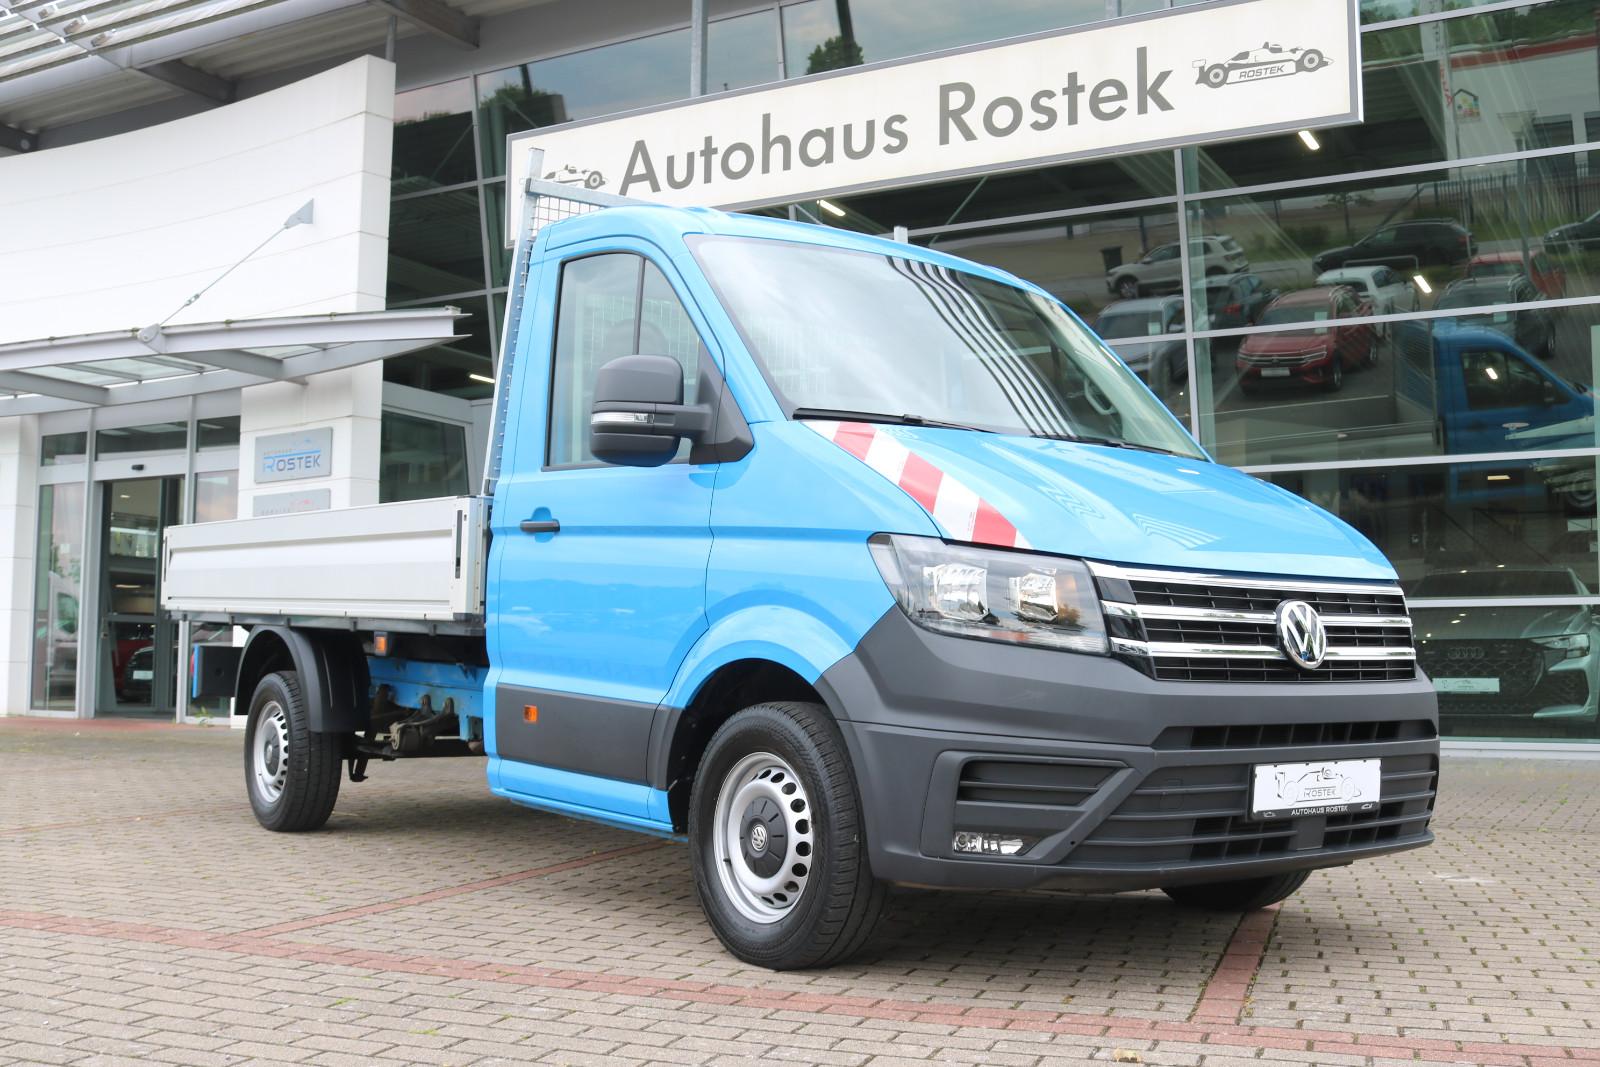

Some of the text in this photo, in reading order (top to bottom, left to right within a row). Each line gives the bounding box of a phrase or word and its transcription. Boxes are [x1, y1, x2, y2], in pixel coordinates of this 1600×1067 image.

[1239, 64, 1285, 80] ROSTEK
[619, 47, 1175, 197] Autohaus Rostek
[263, 453, 321, 472] ROSTEK
[1290, 805, 1348, 816] AUTOHAUS ROSTEK
